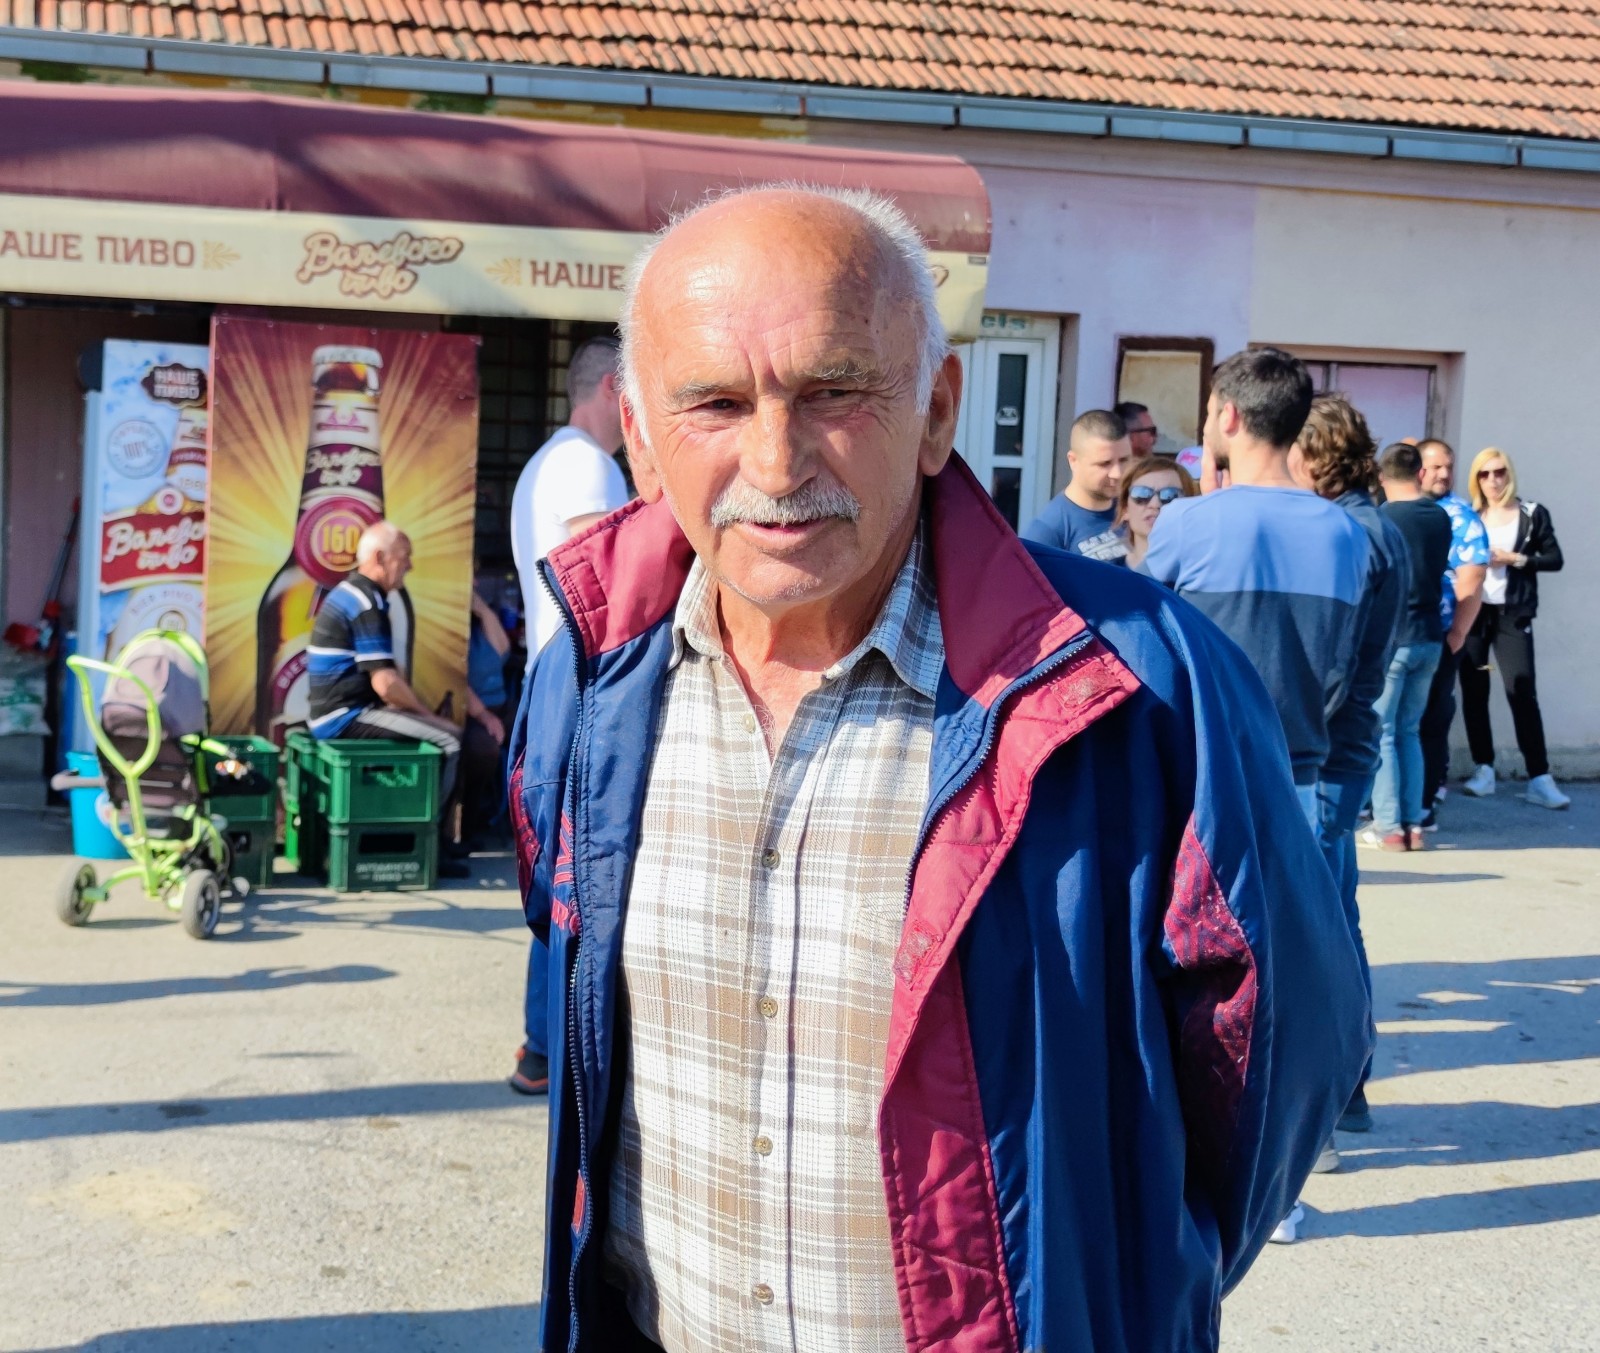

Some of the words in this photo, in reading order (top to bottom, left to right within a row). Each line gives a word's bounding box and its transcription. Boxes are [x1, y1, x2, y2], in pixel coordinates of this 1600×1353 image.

[96, 235, 196, 268] ПИВО
[529, 260, 626, 290] НАШЕ
[154, 384, 200, 399] ПИВО
[322, 525, 360, 554] 160
